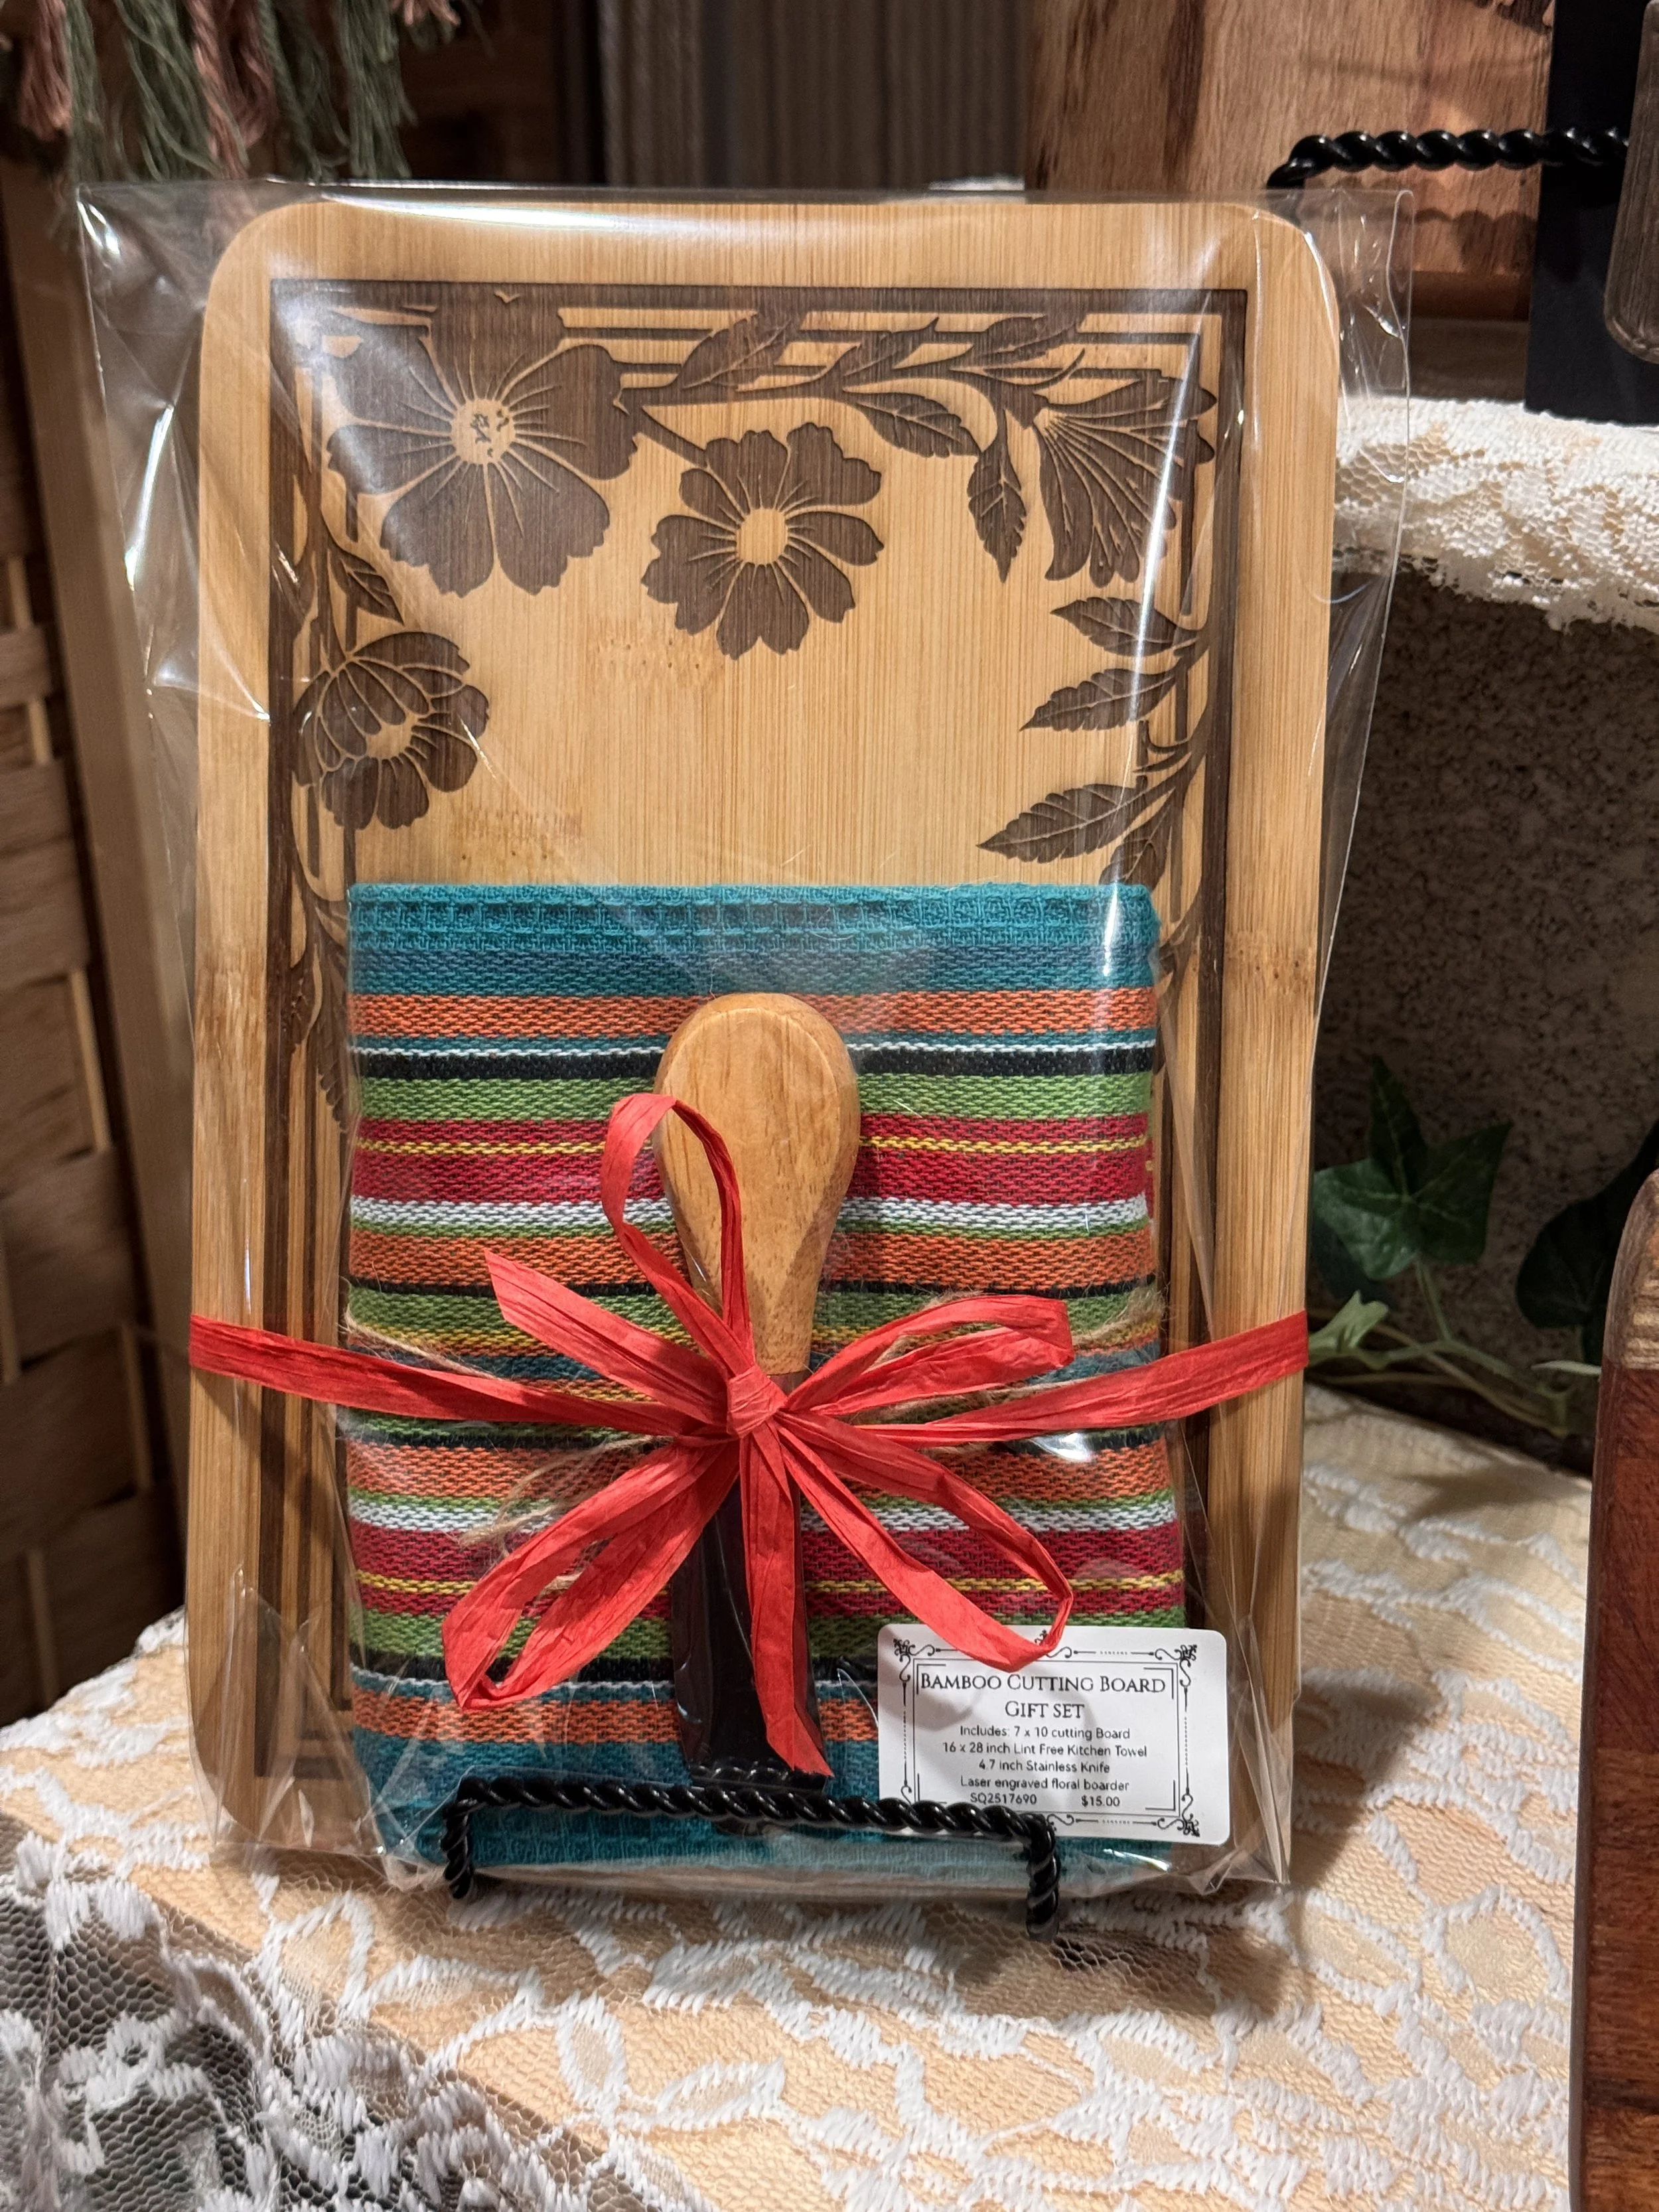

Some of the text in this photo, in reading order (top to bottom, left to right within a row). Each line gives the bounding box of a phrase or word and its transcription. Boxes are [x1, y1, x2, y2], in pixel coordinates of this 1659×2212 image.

[1052, 1703, 1085, 1719] SET
[1013, 1726, 1021, 1737] 7
[1024, 1729, 1031, 1737] x
[1034, 1726, 1048, 1738] 10
[1051, 1728, 1093, 1741] cutting
[1096, 1727, 1131, 1739] Board
[942, 1741, 1147, 1757] 16 x 28 inch Lint Free Kitchen Towel
[978, 1759, 1110, 1774] 4.7 inch Stainless Knife
[960, 1775, 1130, 1792] Laser engraved floral boarder
[970, 1792, 1121, 1807] SQ2517690 $15.00
